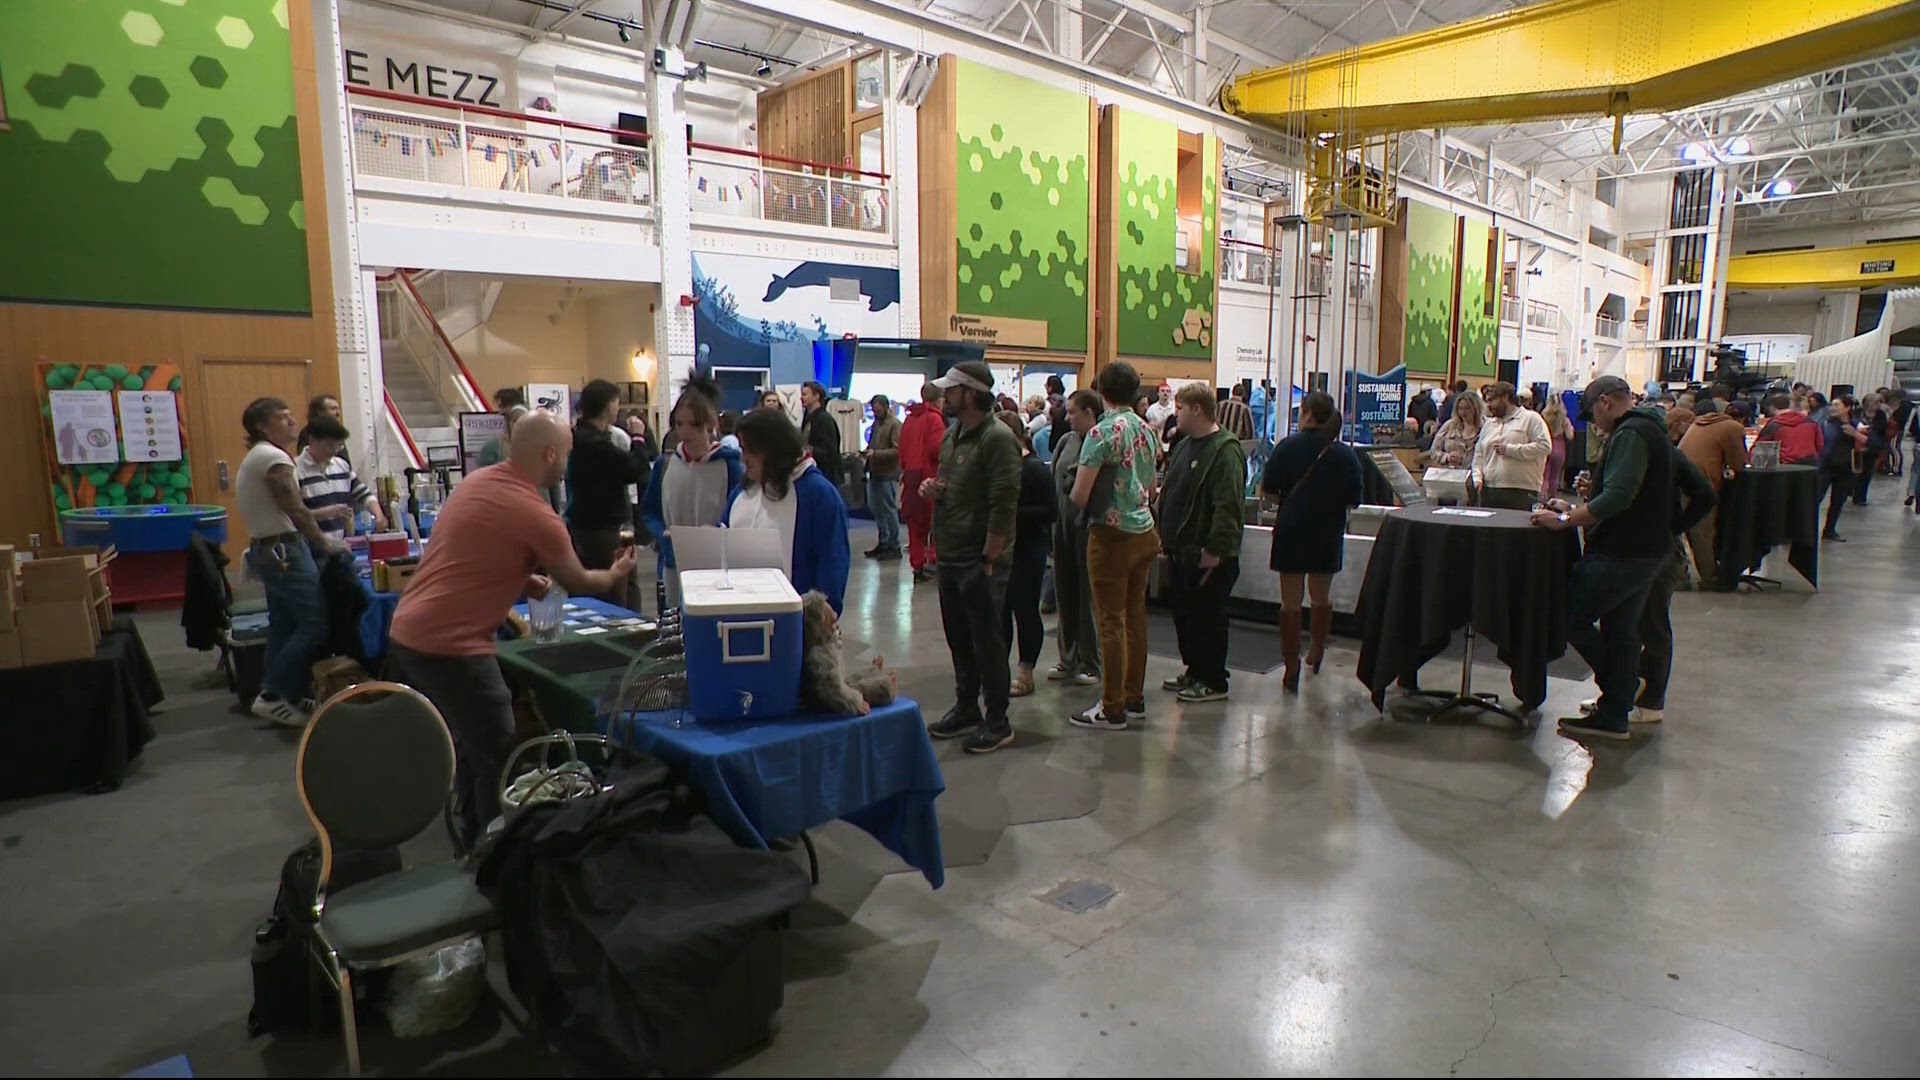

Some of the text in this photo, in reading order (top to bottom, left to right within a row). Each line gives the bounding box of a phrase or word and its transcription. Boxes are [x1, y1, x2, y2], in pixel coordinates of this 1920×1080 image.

[345, 50, 500, 108] E MEZZ
[959, 325, 998, 338] Vernier
[1358, 384, 1402, 393] SUSTAINABLE
[1376, 392, 1401, 402] FISHING
[1379, 402, 1400, 411] PESCA
[1361, 410, 1399, 421] SOSTENIBLE
